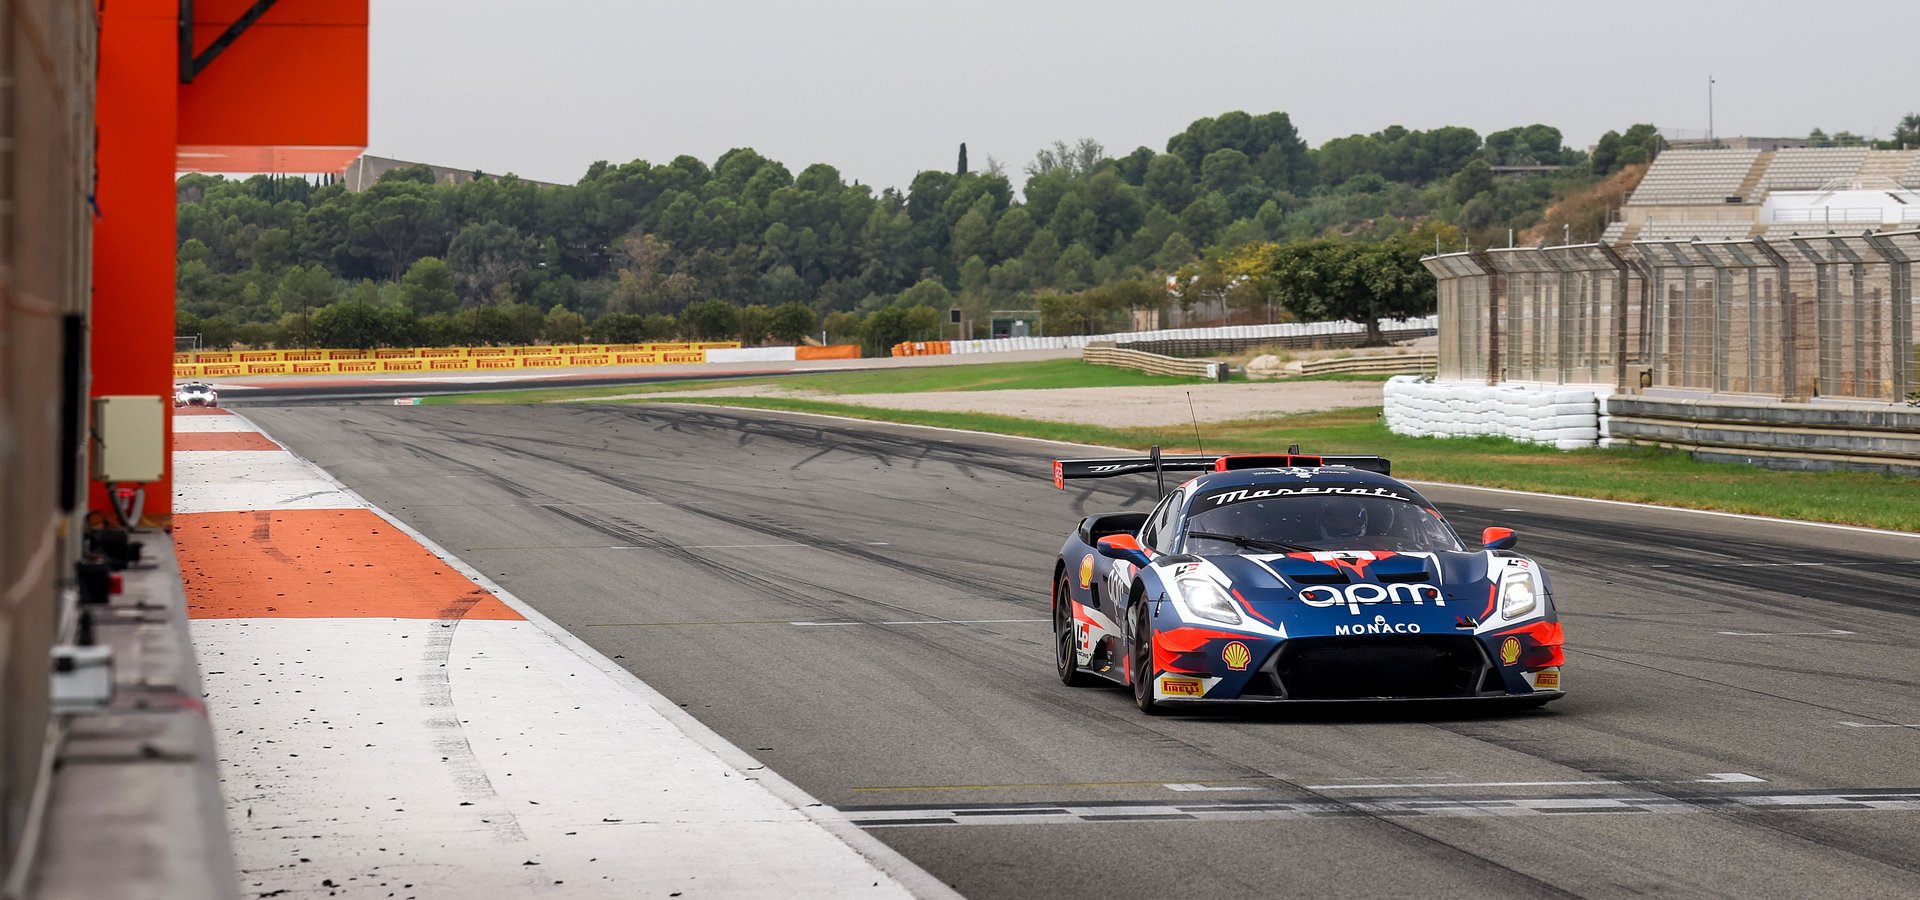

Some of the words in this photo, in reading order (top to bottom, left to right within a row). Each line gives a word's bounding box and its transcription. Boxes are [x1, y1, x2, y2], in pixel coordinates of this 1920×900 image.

[523, 357, 561, 366] PIRELLI
[570, 355, 608, 365] PIRELLI
[617, 354, 655, 363] PIRELLI
[293, 363, 330, 372] PIRELLI
[338, 362, 376, 371] PIRELLI
[384, 361, 422, 370] PIRELLI
[430, 360, 468, 369] PIRELLI
[476, 359, 515, 368] PIRELLI
[204, 365, 240, 374] PIRELLI
[248, 364, 285, 373] PIRELLI
[1207, 487, 1410, 504] Maserati
[1298, 583, 1446, 615] apm
[1335, 623, 1420, 636] MONACO
[1164, 680, 1199, 693] PIRELLI
